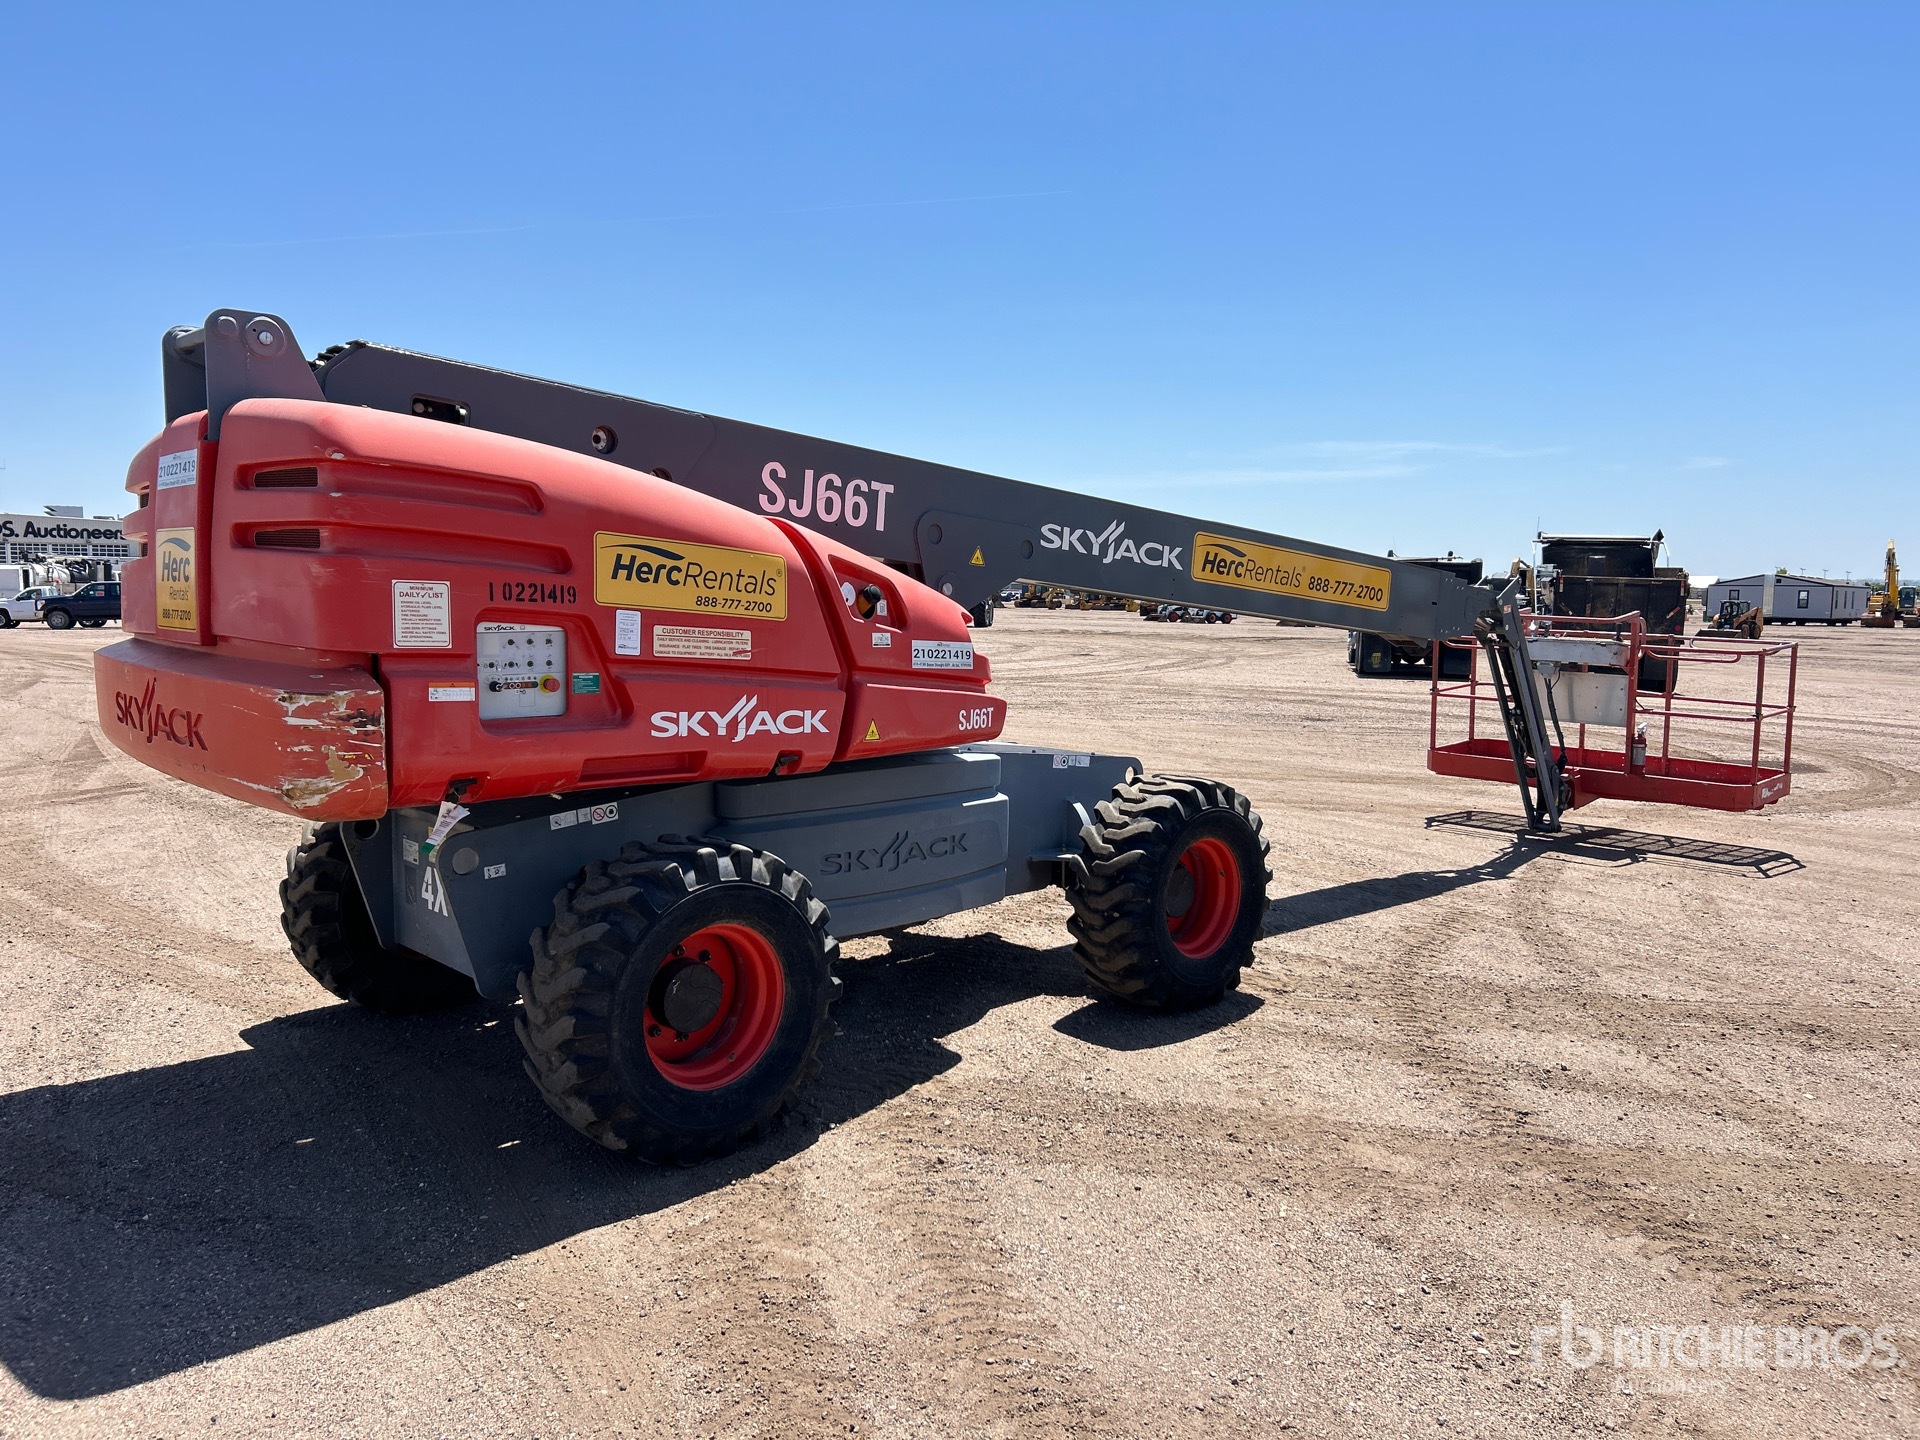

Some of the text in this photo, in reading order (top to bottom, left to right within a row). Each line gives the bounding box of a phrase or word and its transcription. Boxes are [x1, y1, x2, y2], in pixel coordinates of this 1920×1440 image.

[158, 460, 196, 478] 210221419
[758, 461, 894, 531] SJ66T
[1040, 520, 1184, 570] SKYJACK
[161, 551, 190, 582] Herc
[169, 586, 189, 601] Rentals
[1308, 576, 1384, 602] 888-777-2700
[162, 608, 192, 621] 888-777-2700
[696, 596, 772, 612] 888-777-2700
[698, 629, 744, 638] RESPONSIBILITY
[914, 648, 970, 660] 210221419
[115, 677, 208, 751] SKYJACK
[650, 694, 830, 742] SKYJACK
[958, 707, 994, 730] SJ66T
[820, 831, 968, 875] SKYJACK
